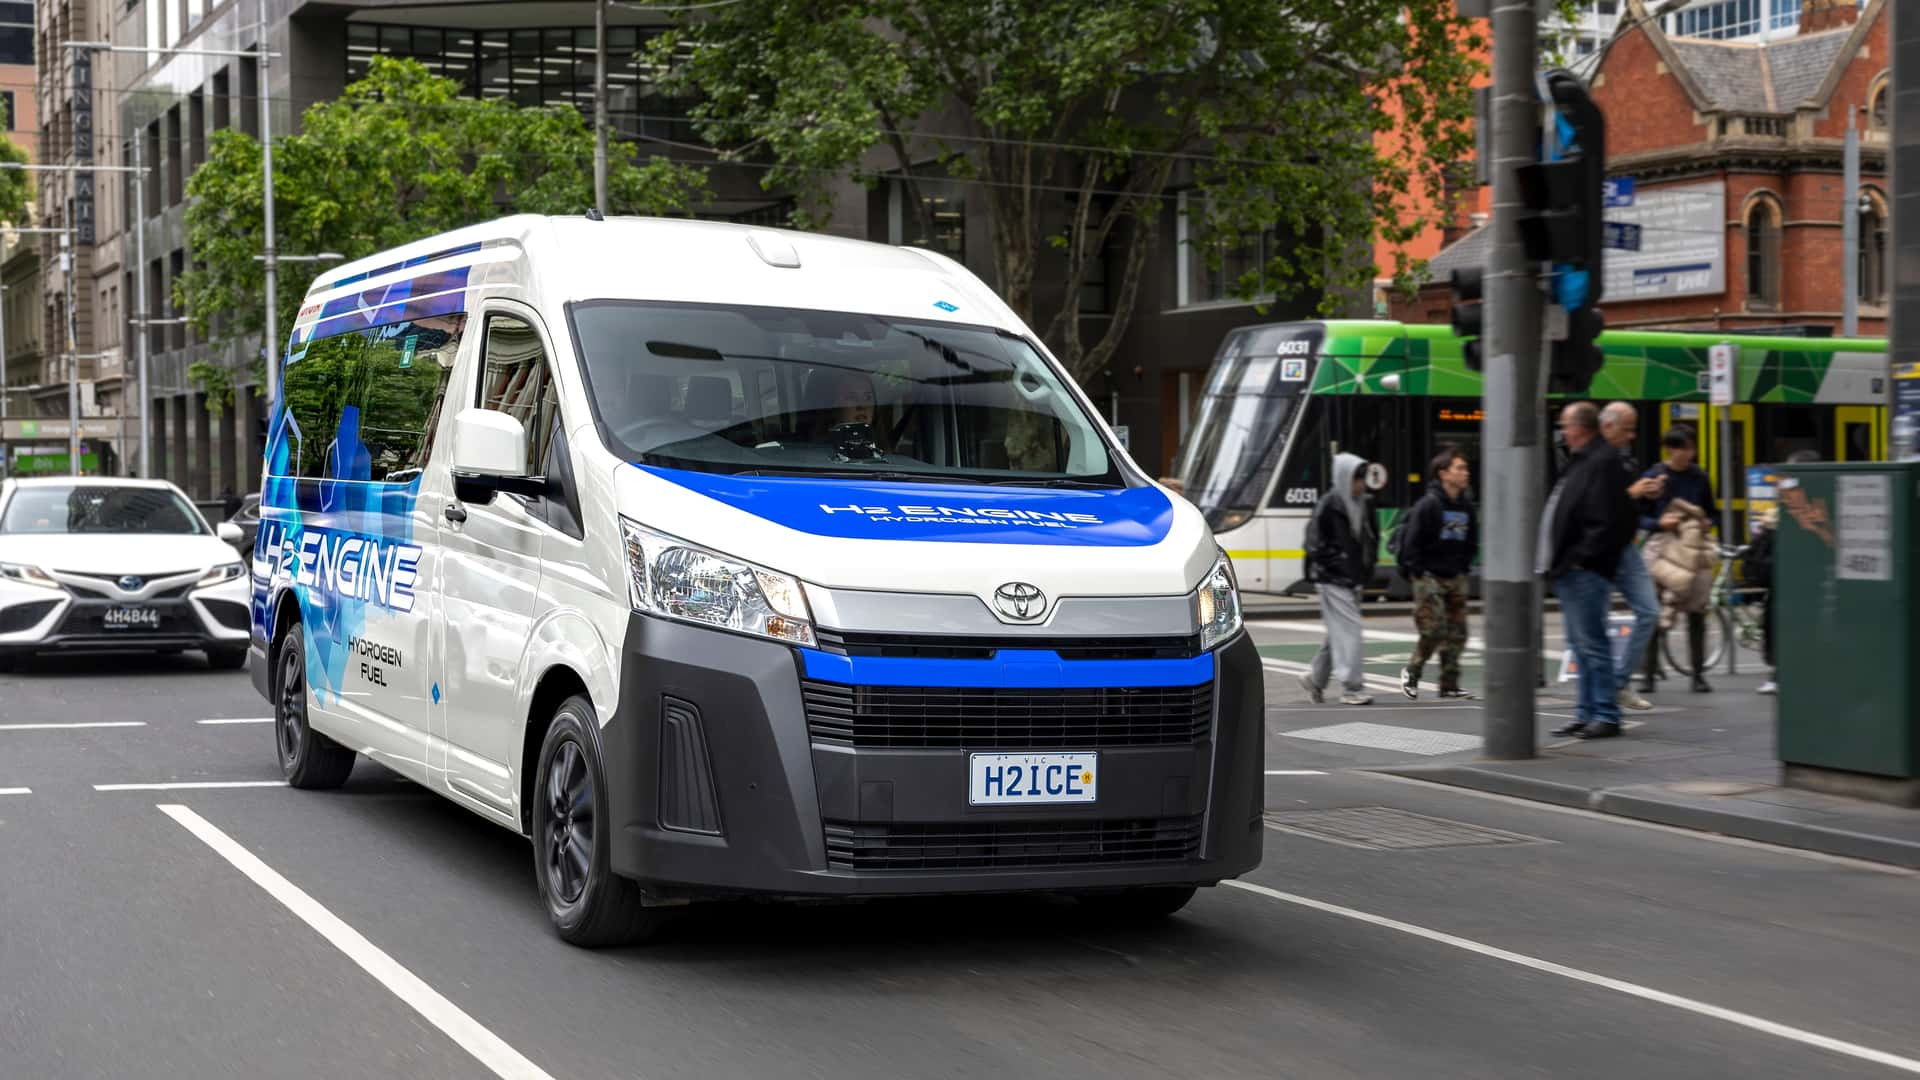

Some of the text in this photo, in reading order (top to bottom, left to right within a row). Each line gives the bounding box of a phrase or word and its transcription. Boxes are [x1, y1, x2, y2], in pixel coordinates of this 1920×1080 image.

[1277, 340, 1310, 354] 6031
[1285, 488, 1318, 503] 6031
[819, 503, 1105, 524] H2 ENGINE
[870, 515, 1078, 529] HYDROGEN FUEL
[296, 531, 423, 613] ENGINE
[347, 634, 402, 668] HYDROGEN
[360, 662, 387, 687] FUEL
[1024, 756, 1047, 764] VIC
[985, 764, 1083, 796] H2ICE
